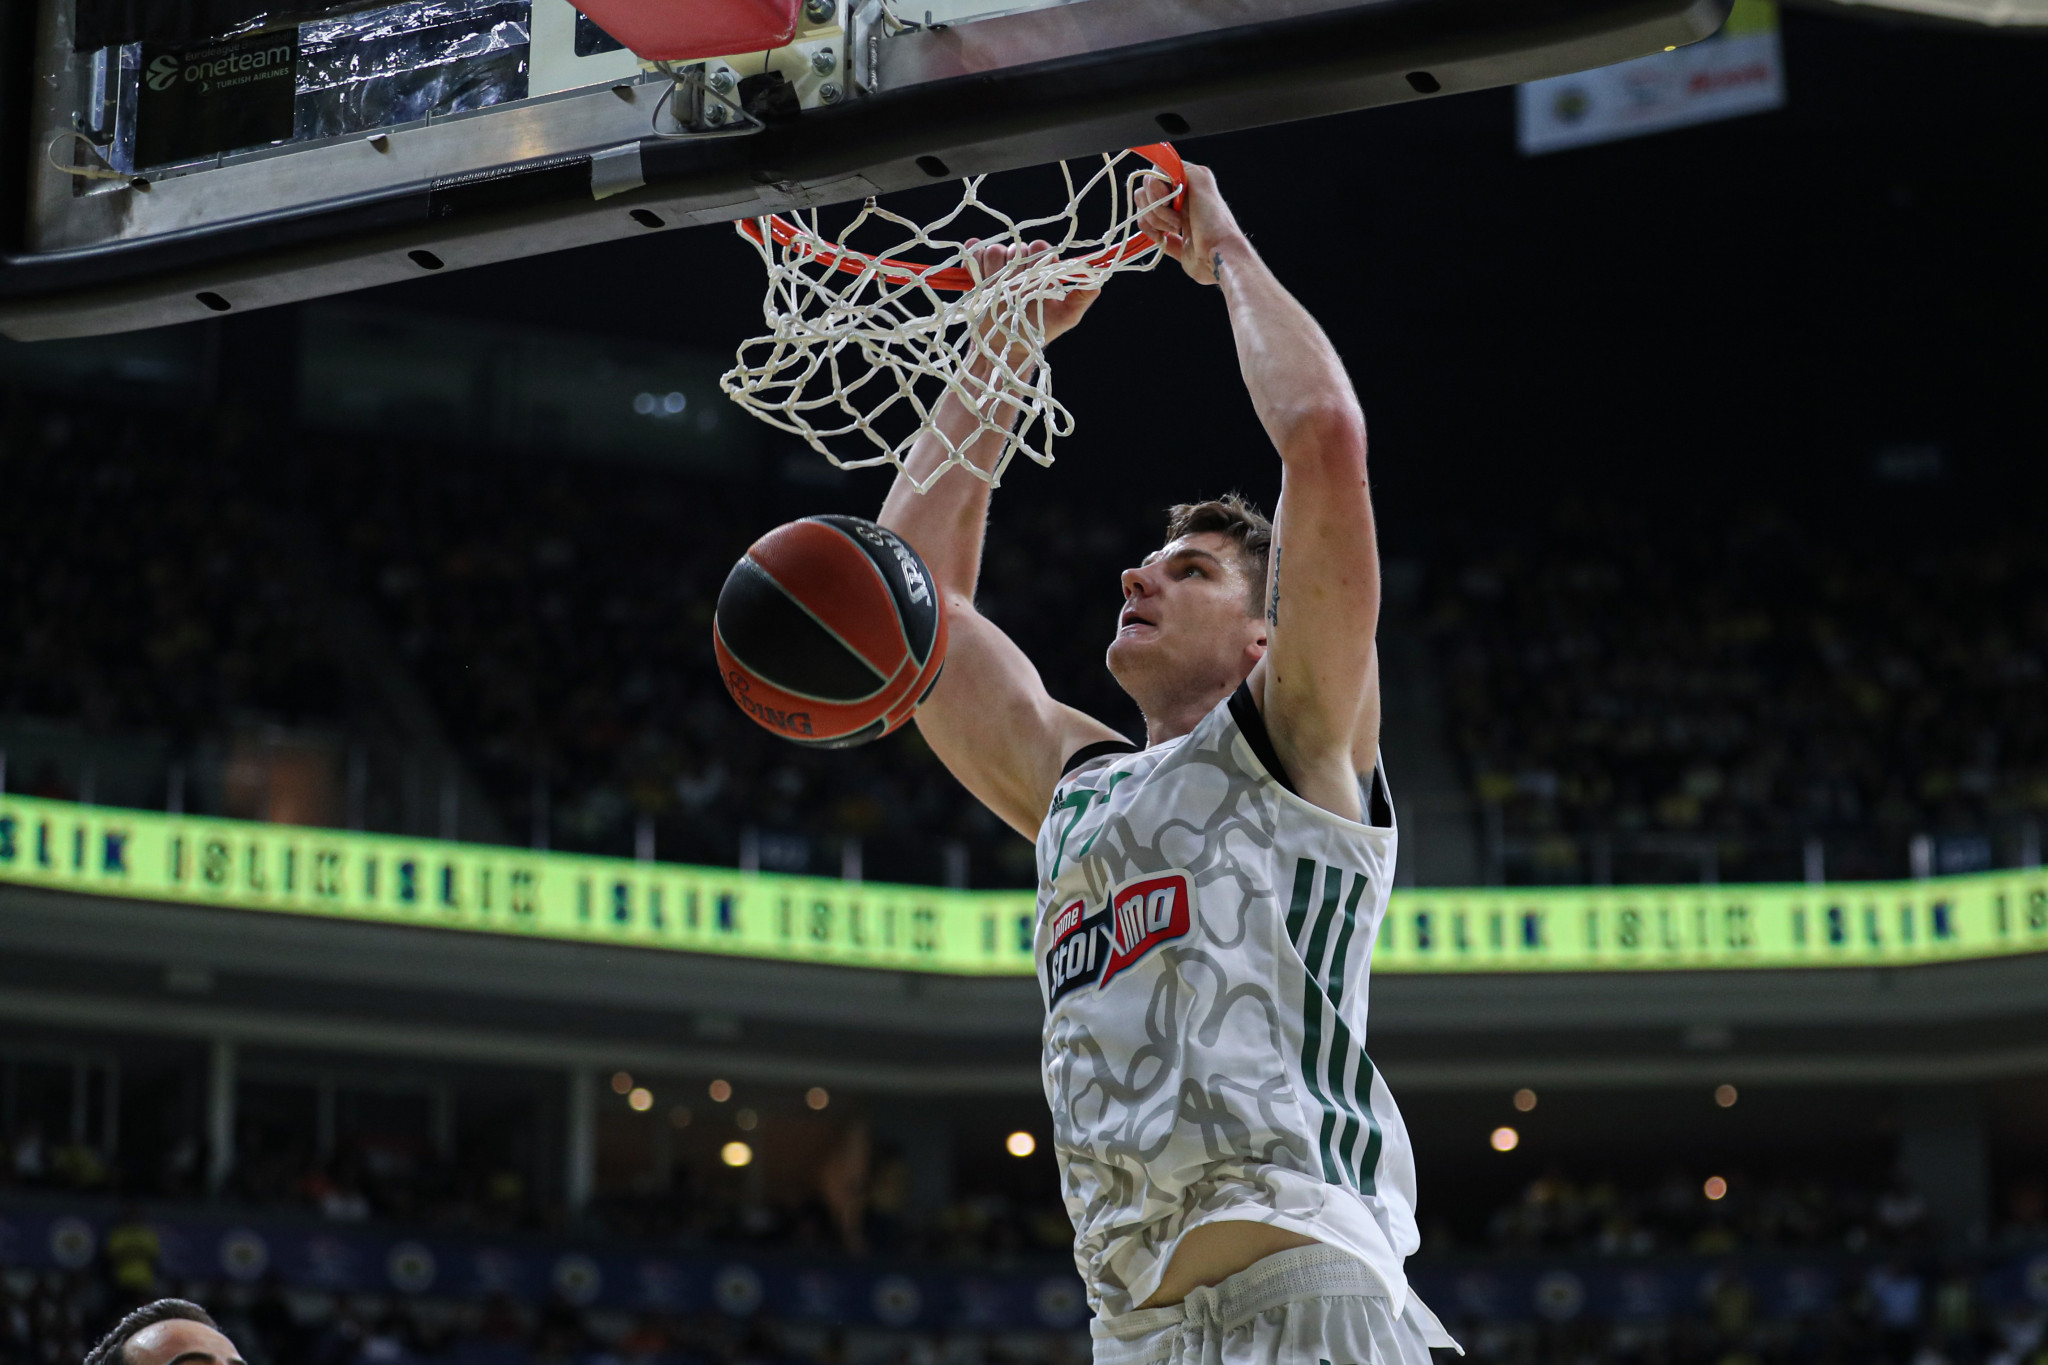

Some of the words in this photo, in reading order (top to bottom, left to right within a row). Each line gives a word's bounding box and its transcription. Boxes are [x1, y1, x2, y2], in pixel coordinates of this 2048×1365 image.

[184, 45, 291, 82] oneteam
[216, 76, 251, 89] TURKISH
[252, 67, 290, 82] AIRLINES
